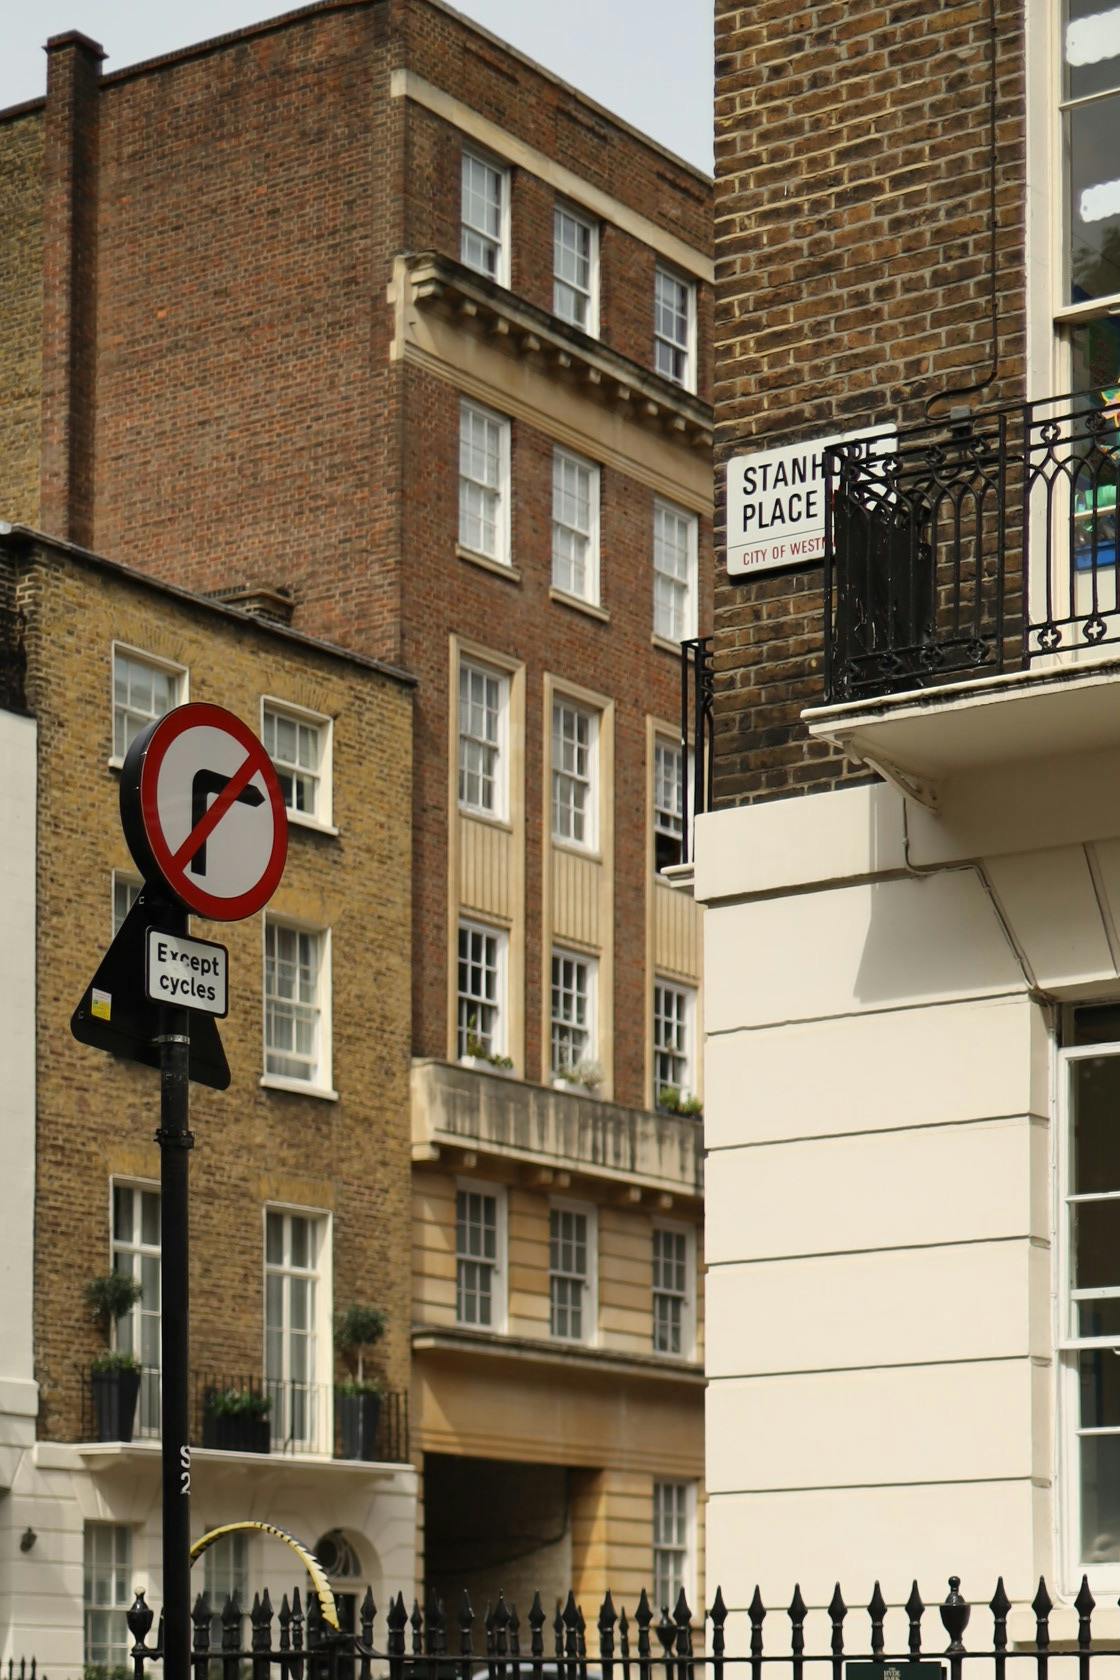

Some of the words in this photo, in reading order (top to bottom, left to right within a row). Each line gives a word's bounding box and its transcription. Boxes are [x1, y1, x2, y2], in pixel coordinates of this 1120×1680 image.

[743, 490, 818, 532] PLACE
[743, 549, 768, 565] CITY
[772, 545, 786, 560] OF
[157, 942, 219, 976] Except
[159, 973, 216, 1001] cycles
